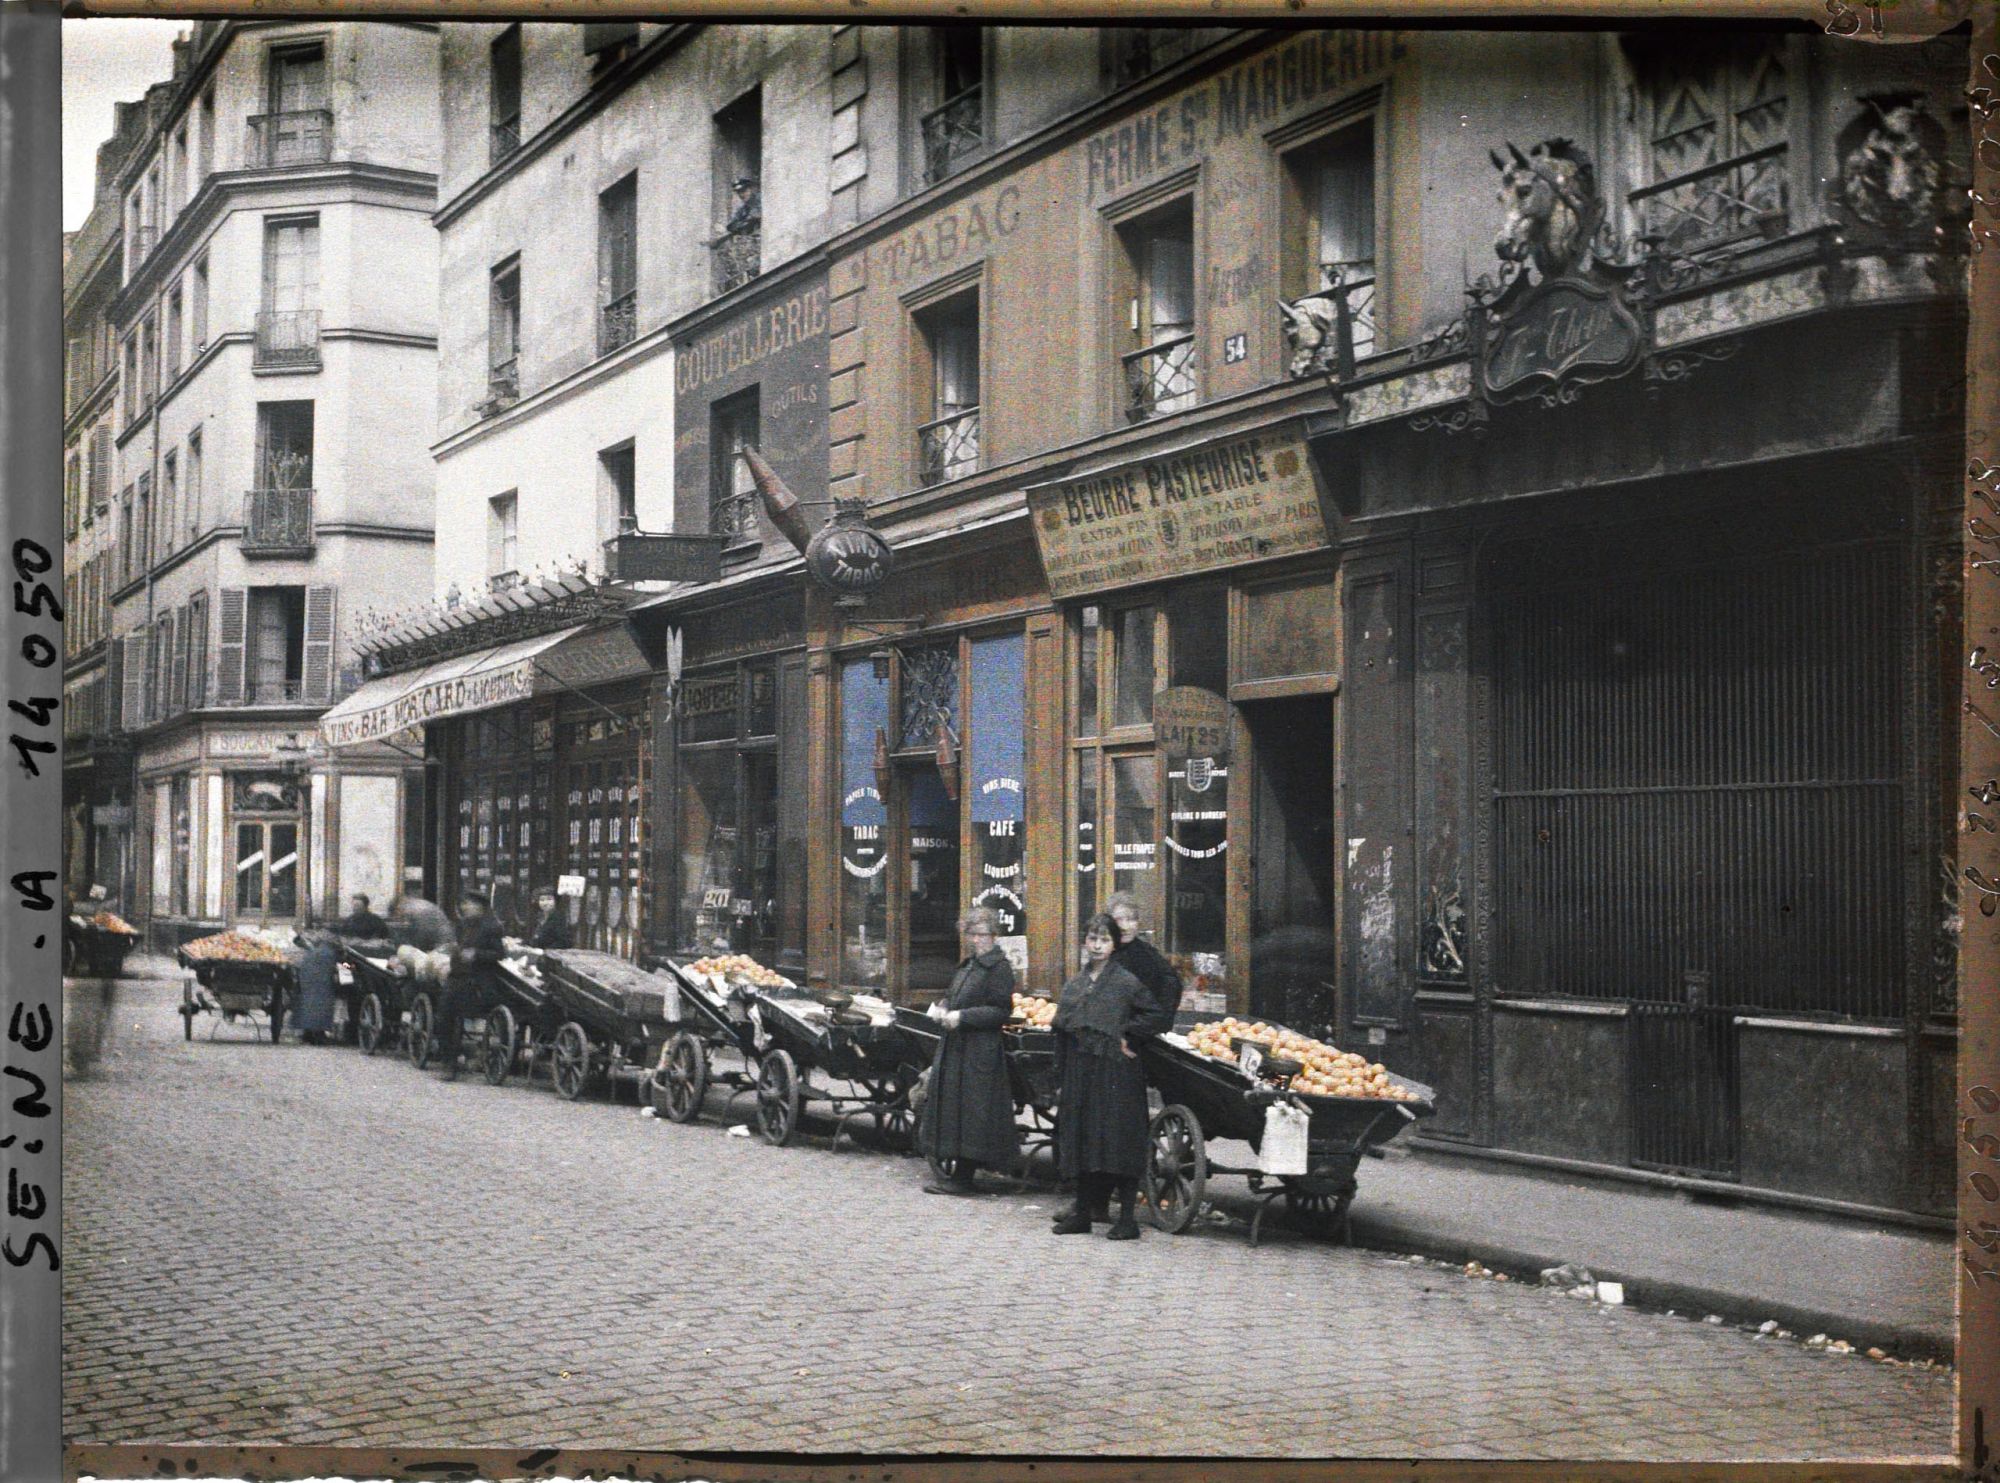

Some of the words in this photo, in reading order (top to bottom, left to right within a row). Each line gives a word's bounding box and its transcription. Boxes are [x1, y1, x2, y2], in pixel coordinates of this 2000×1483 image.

[1087, 107, 1170, 202] FERME
[883, 185, 1021, 284] TABAC
[676, 286, 826, 395] COUTELLERIE
[1225, 334, 1245, 364] 54
[1062, 471, 1142, 527] BEURRE
[1080, 525, 1123, 544] EXTRA
[1215, 493, 1263, 515] TABLE
[827, 530, 880, 559] VINS
[831, 559, 883, 585] TABAC
[8, 537, 64, 778] 14050
[853, 825, 879, 840] TABAC
[989, 814, 1016, 837] CAFÉ
